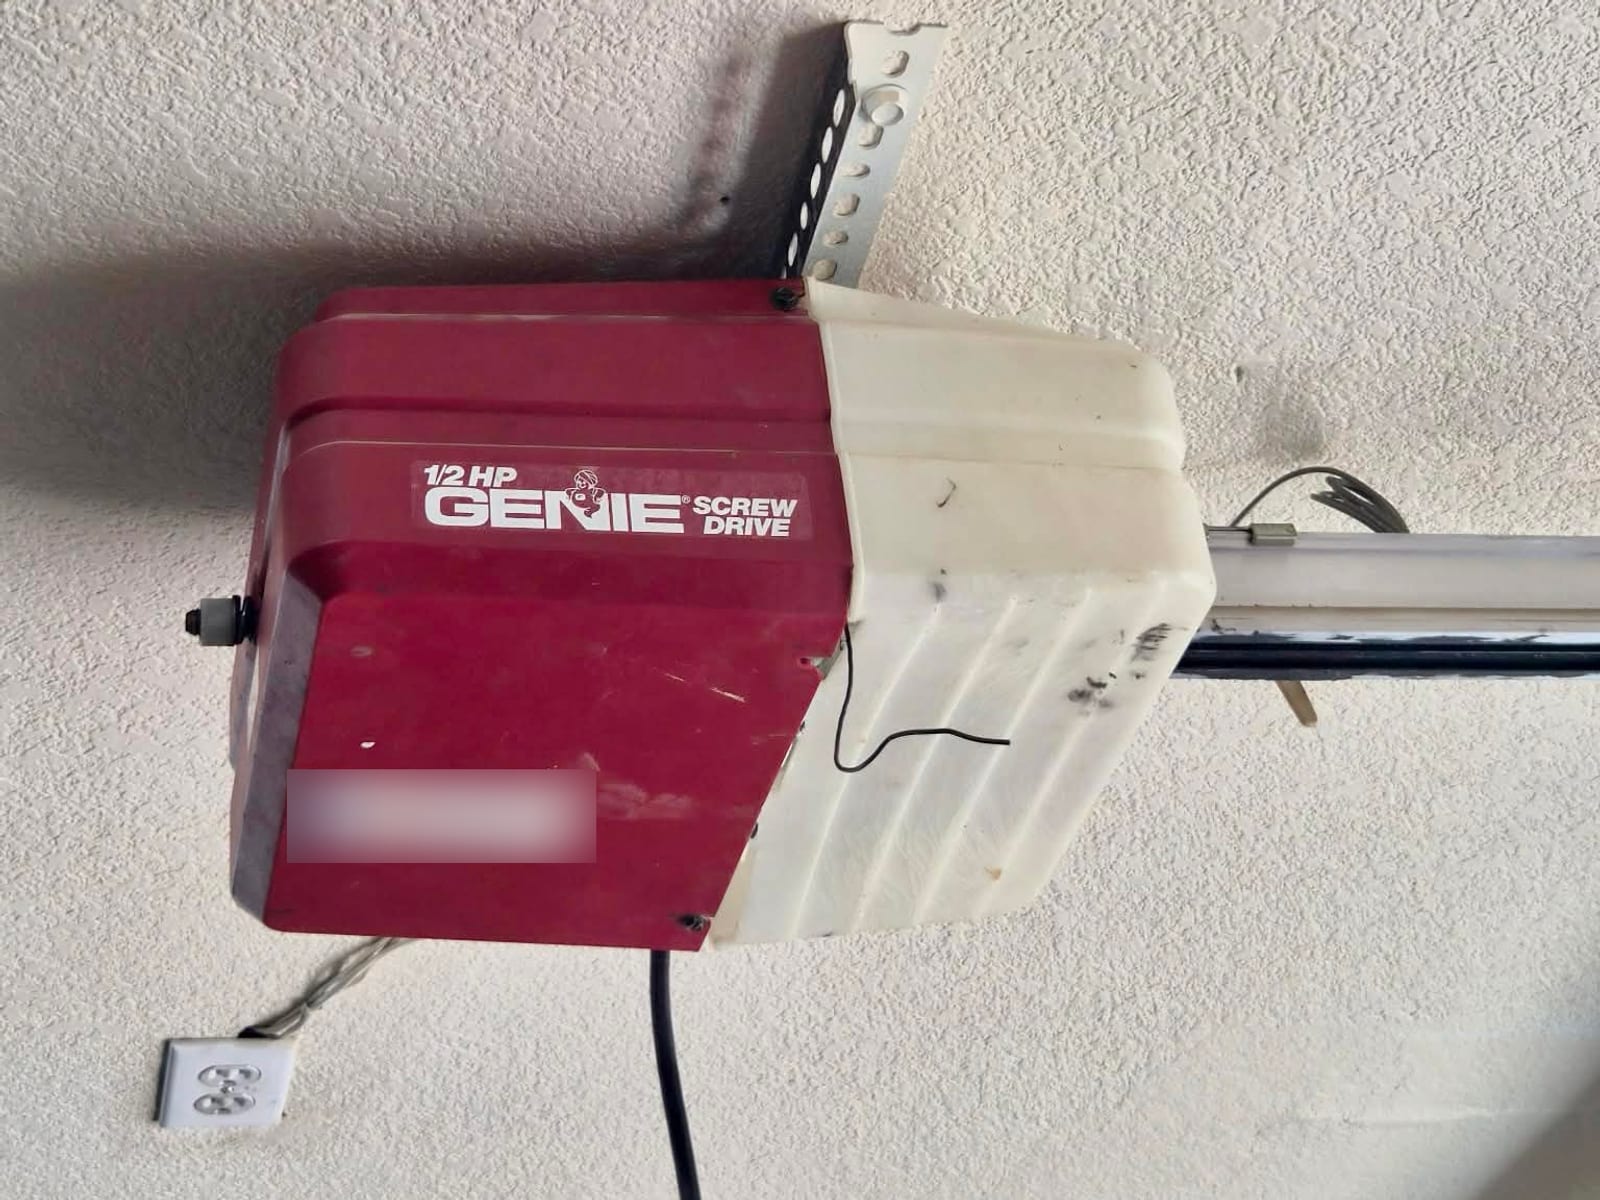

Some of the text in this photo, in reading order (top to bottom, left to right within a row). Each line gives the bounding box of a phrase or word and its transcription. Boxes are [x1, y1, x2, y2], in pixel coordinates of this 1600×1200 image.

[424, 464, 518, 488] 1/2 HP
[692, 496, 798, 517] SCREW
[703, 516, 791, 537] DRIVE
